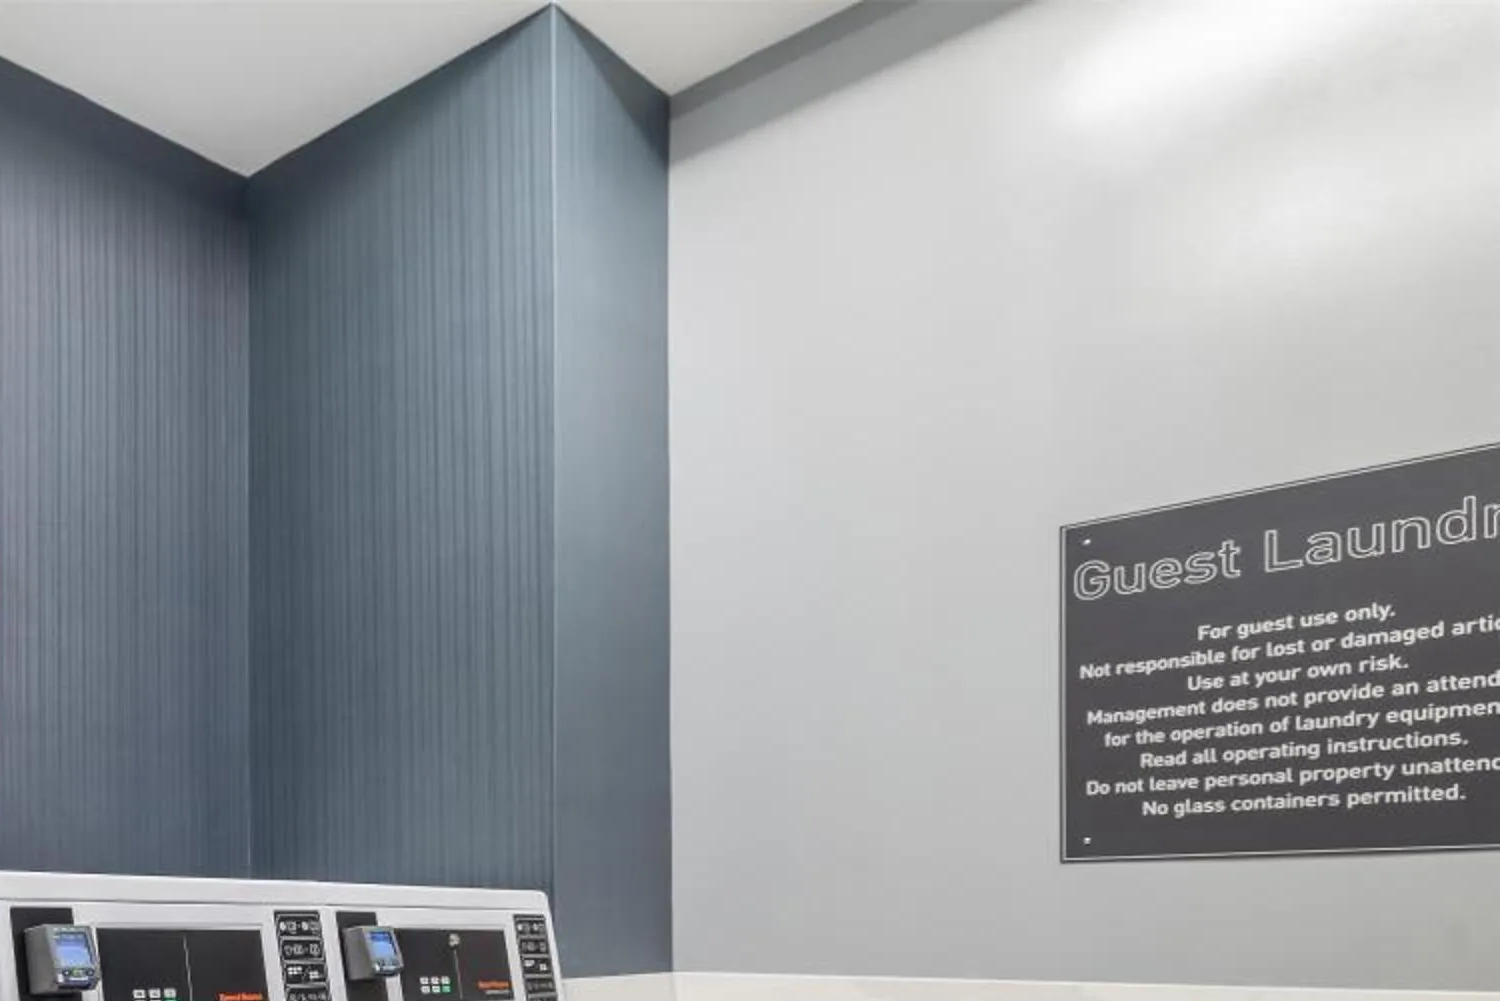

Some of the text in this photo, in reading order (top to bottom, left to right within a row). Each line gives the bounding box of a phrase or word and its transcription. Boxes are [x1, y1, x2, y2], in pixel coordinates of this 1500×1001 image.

[1073, 539, 1242, 601] Guest
[1197, 601, 1396, 641] For guest use only.
[1079, 662, 1112, 680] Not
[1115, 648, 1227, 676] responsible
[1230, 645, 1262, 662] for
[1265, 639, 1306, 658] lost
[1310, 637, 1336, 653] or
[1339, 620, 1445, 649] damaged
[1187, 653, 1409, 692] Use at your own risk.
[1086, 700, 1207, 725] Management
[1210, 697, 1260, 714] does
[1264, 691, 1299, 709] not
[1303, 681, 1386, 709] provide
[1390, 681, 1420, 697] an
[1104, 701, 1500, 748] for the operation of laundry equipmen
[1139, 731, 1469, 769] Read all operating instructions.
[1085, 780, 1111, 796] Do
[1114, 778, 1145, 794] not
[1149, 776, 1200, 792] leave
[1203, 767, 1294, 792] personal
[1299, 762, 1396, 787] property
[1141, 783, 1467, 819] No glass containers permitted.
